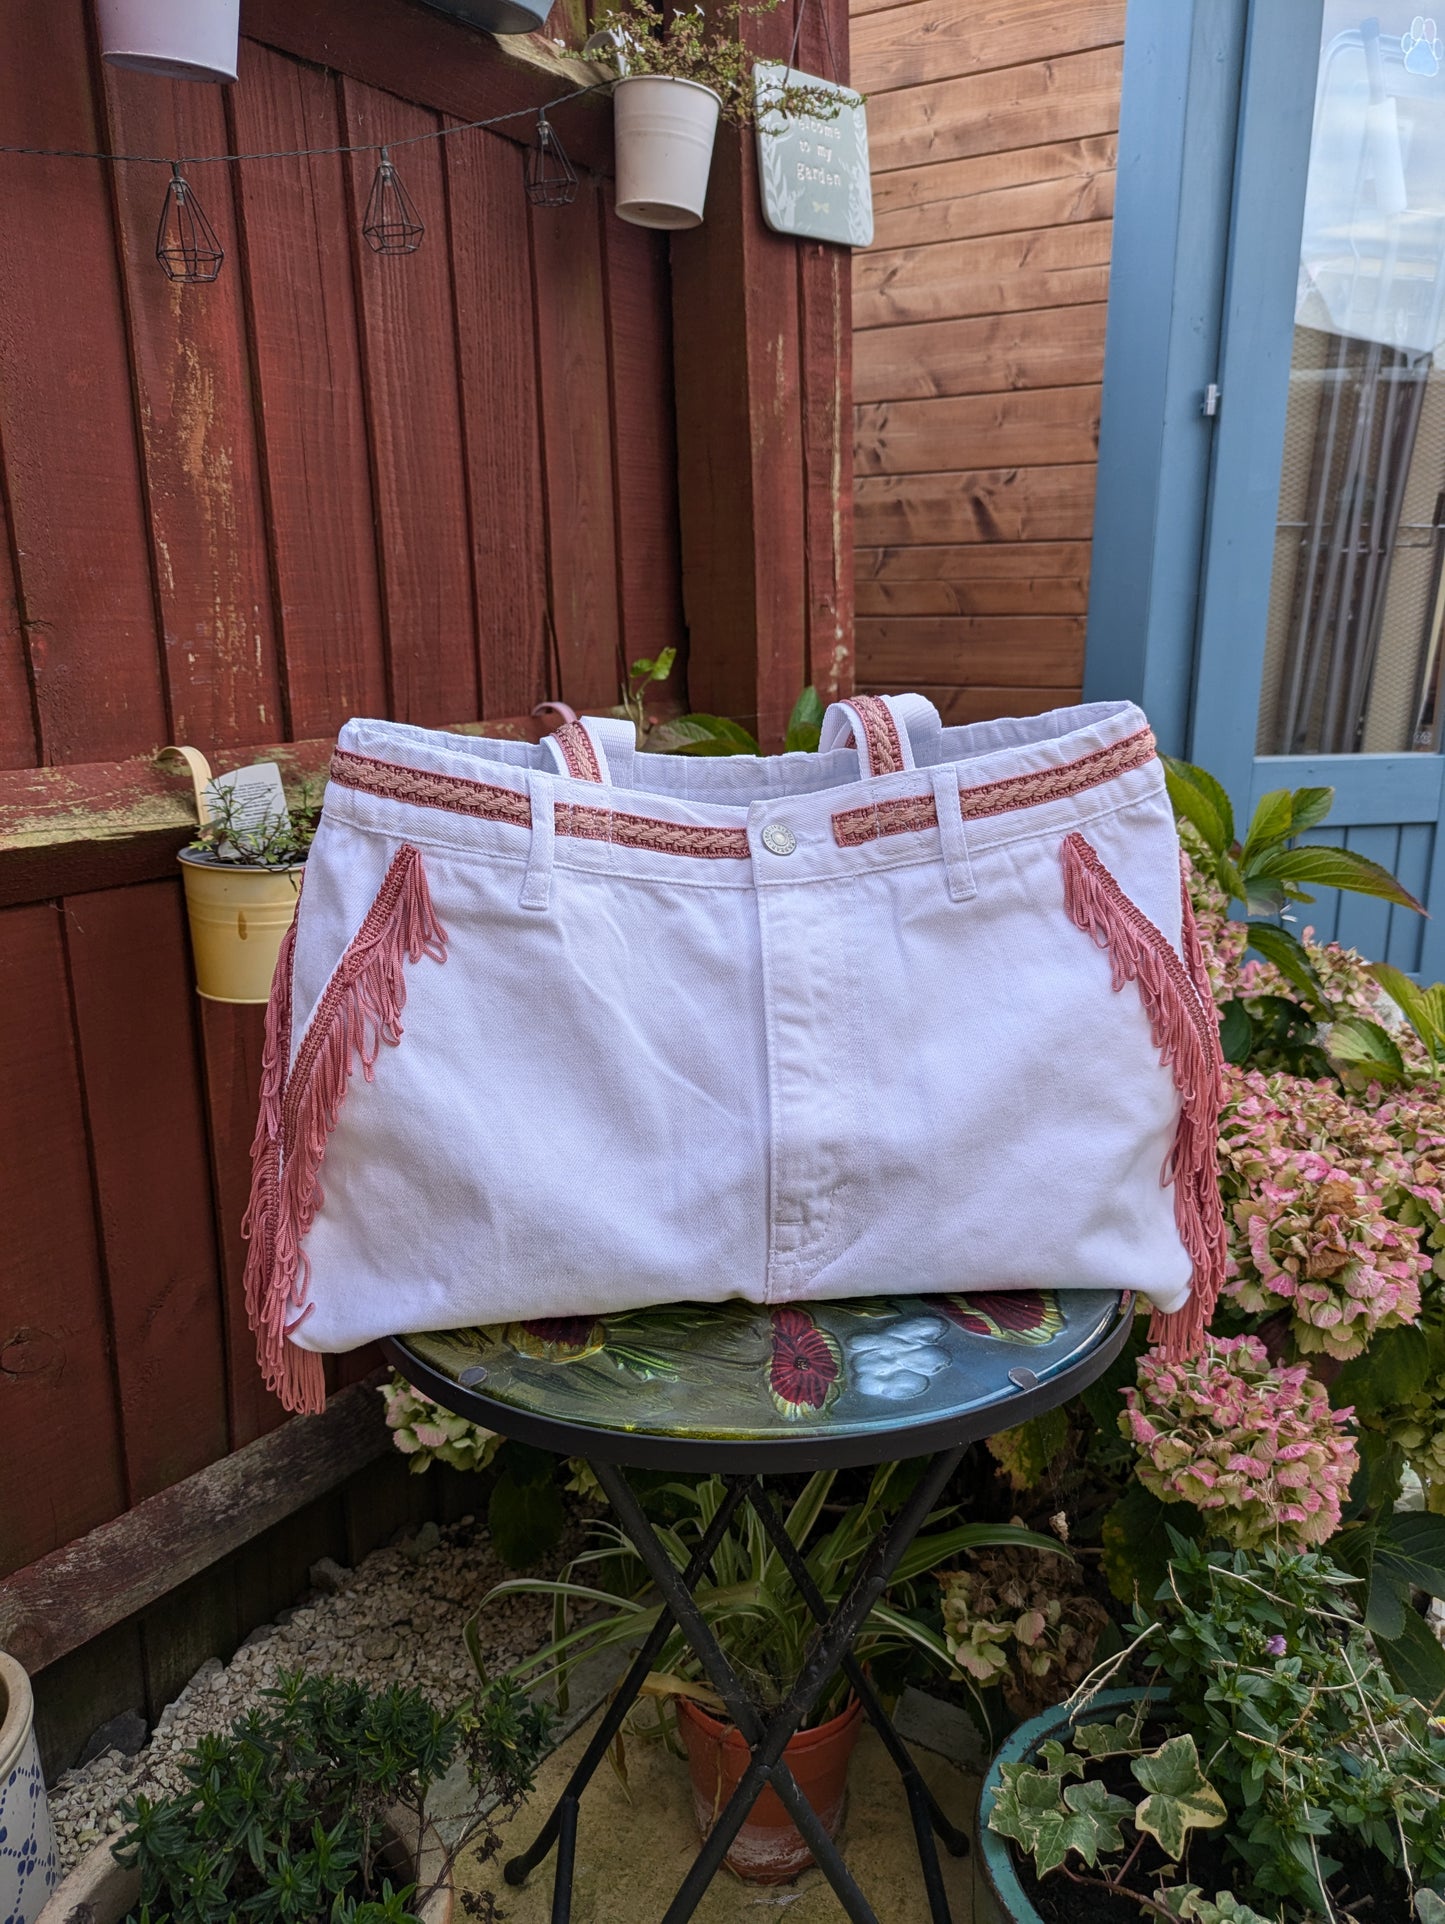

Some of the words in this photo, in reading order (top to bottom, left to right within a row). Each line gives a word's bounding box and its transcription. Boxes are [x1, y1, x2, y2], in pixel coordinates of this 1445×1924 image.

[799, 140, 810, 152] to
[817, 145, 832, 162] my
[797, 162, 841, 186] garden
